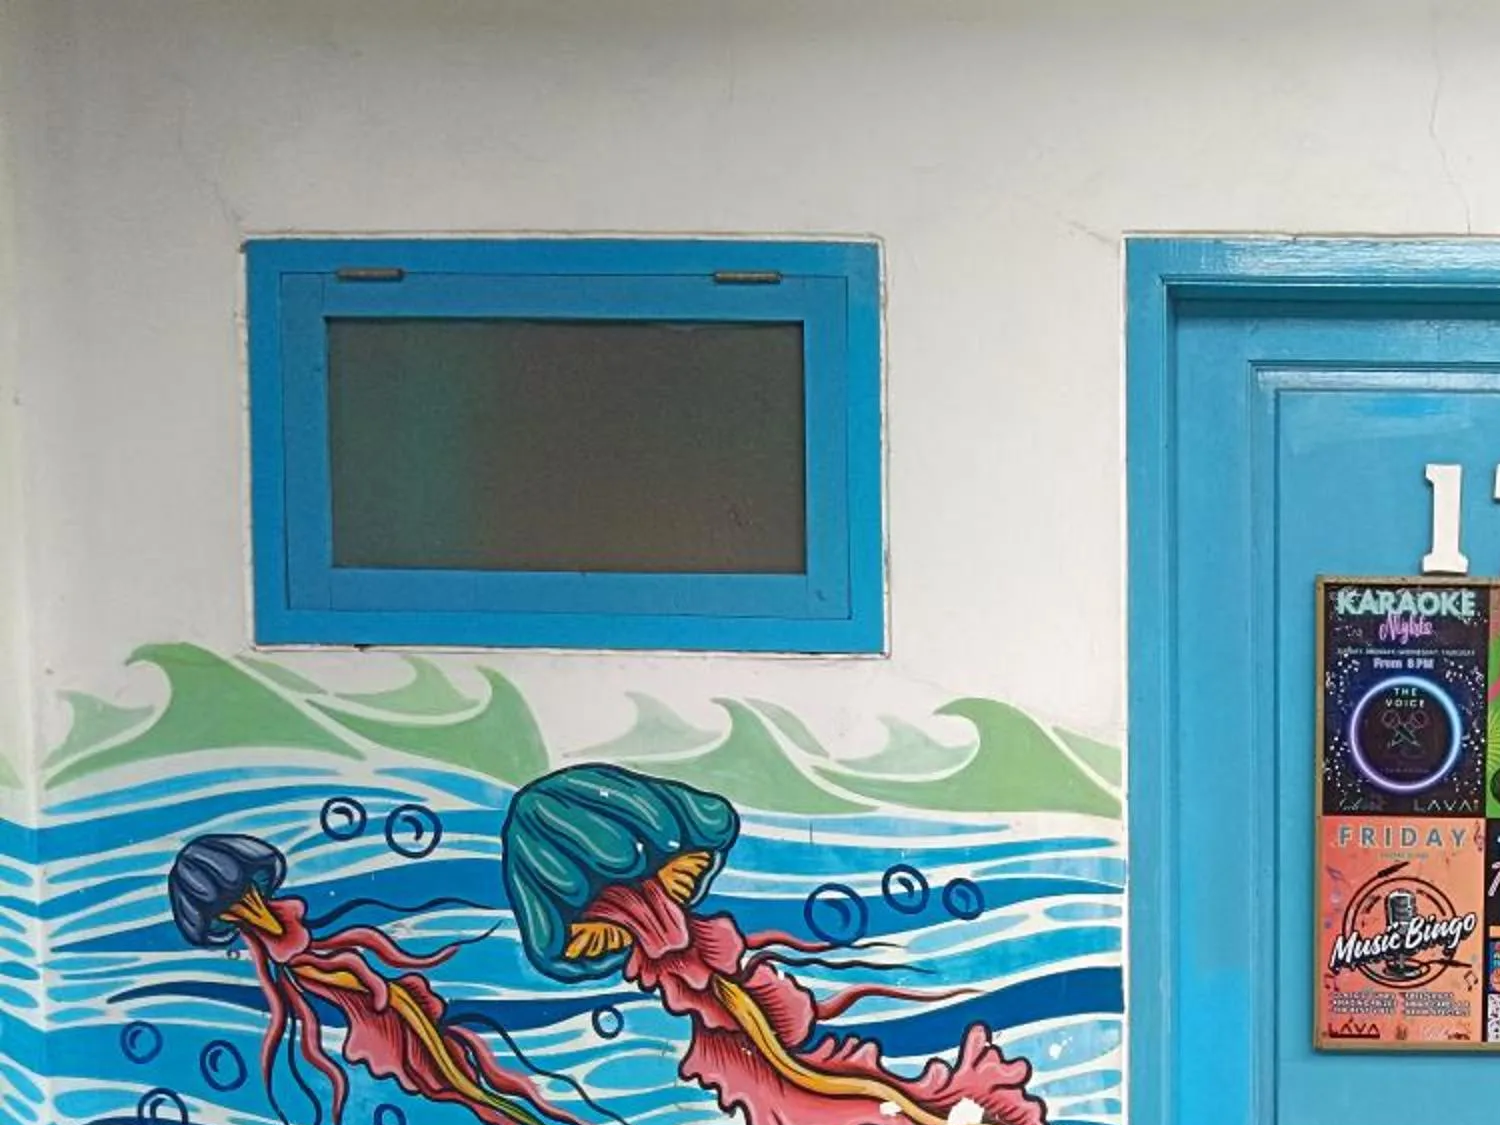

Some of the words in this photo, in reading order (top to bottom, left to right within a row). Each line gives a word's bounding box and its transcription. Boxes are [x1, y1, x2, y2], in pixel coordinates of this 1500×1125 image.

[1336, 589, 1476, 616] KARAOKE
[1379, 612, 1433, 644] Nights
[1373, 657, 1403, 669] From
[1394, 687, 1418, 696] THE
[1385, 699, 1425, 709] VOICE
[1413, 799, 1472, 812] LAVA
[1338, 825, 1466, 849] FRIDAY
[1329, 921, 1401, 968] Music
[1404, 912, 1477, 949] Bingo
